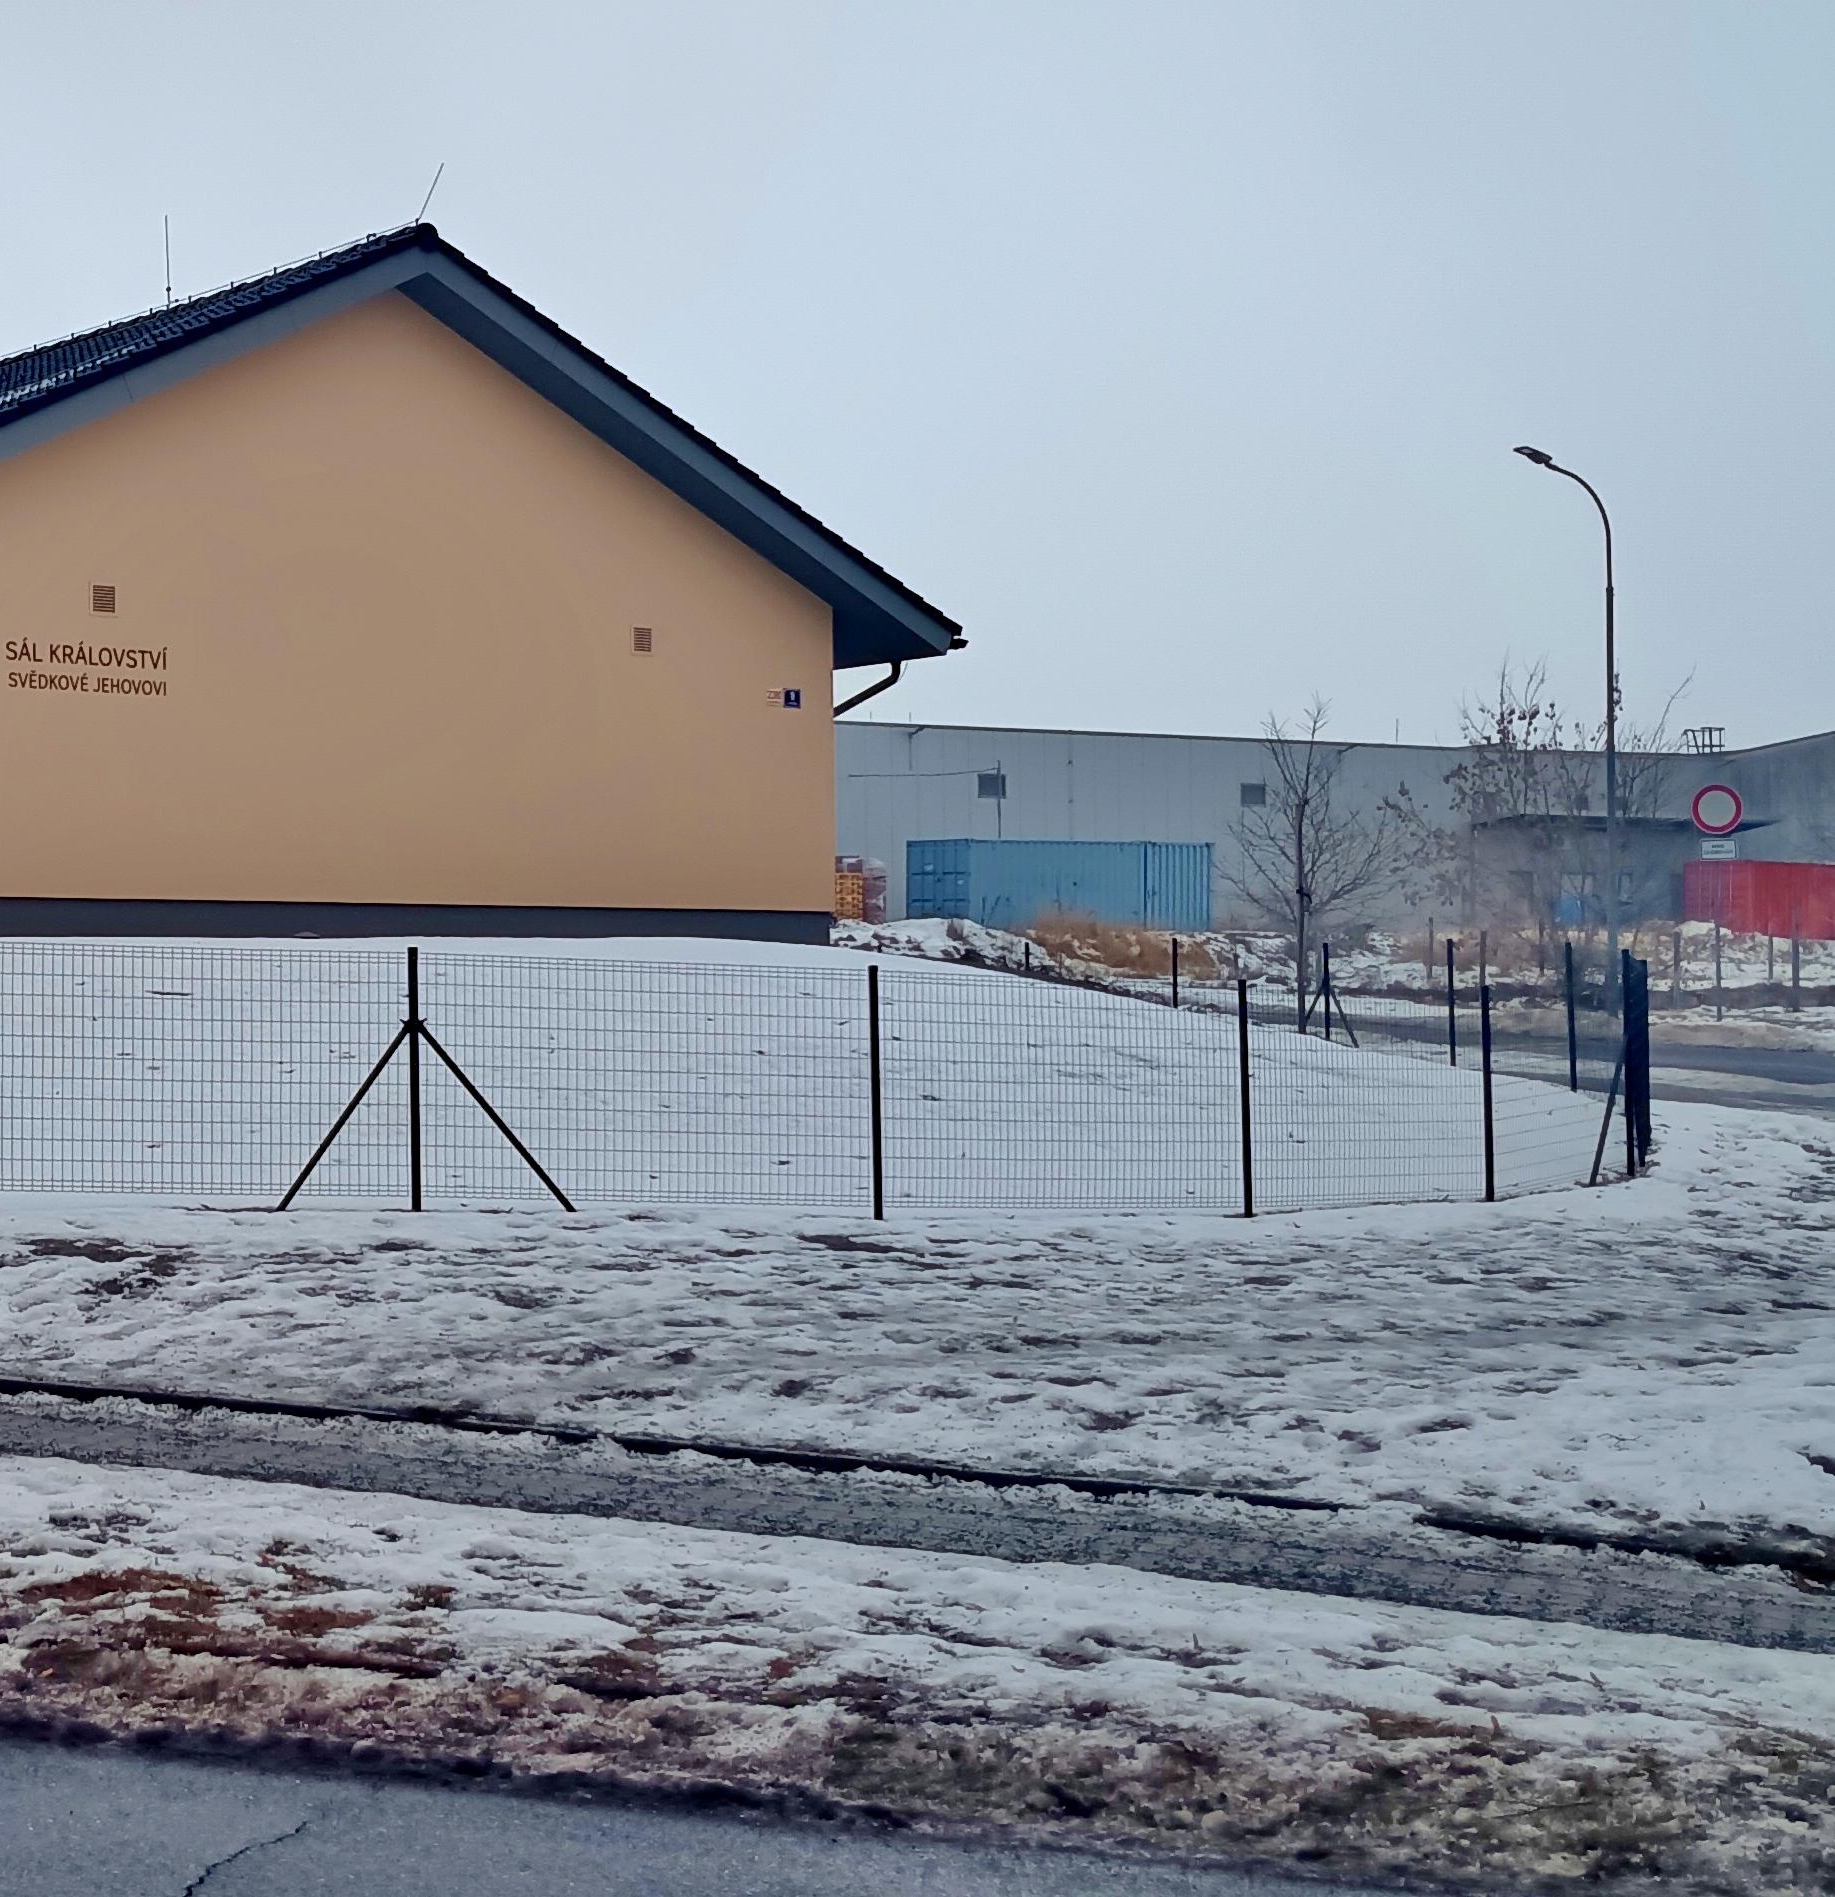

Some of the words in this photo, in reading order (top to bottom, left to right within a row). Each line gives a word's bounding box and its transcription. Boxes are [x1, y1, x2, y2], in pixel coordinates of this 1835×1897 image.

[5, 637, 43, 663] SÁL
[49, 641, 167, 670] KRÁLOVSTVÍ
[8, 670, 89, 692] SVĚDKOVÉ
[93, 678, 167, 696] JEHOVOVI
